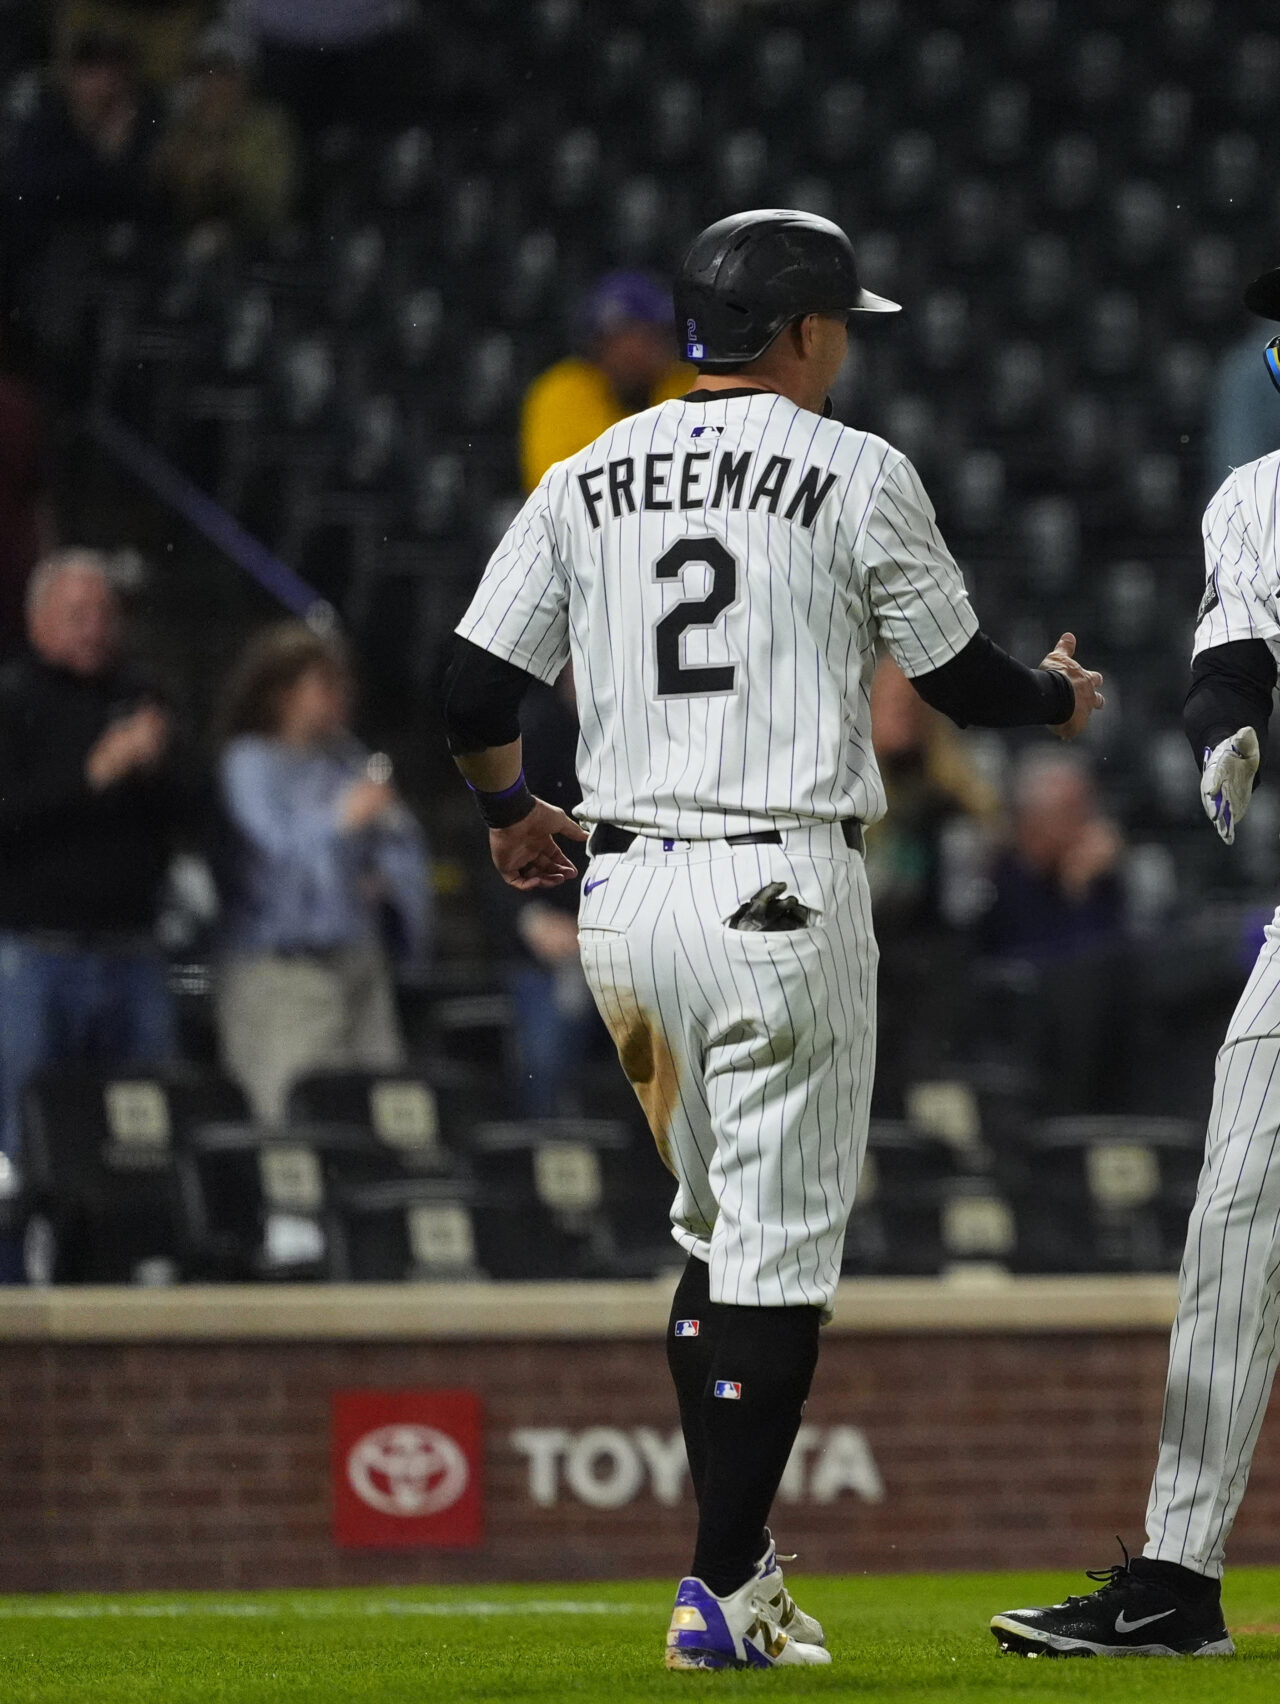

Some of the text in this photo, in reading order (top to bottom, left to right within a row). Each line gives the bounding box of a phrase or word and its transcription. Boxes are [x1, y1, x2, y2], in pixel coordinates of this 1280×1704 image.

[577, 450, 841, 532] FREEMAN
[651, 533, 741, 701] 2
[510, 1425, 886, 1509] TOYTA
